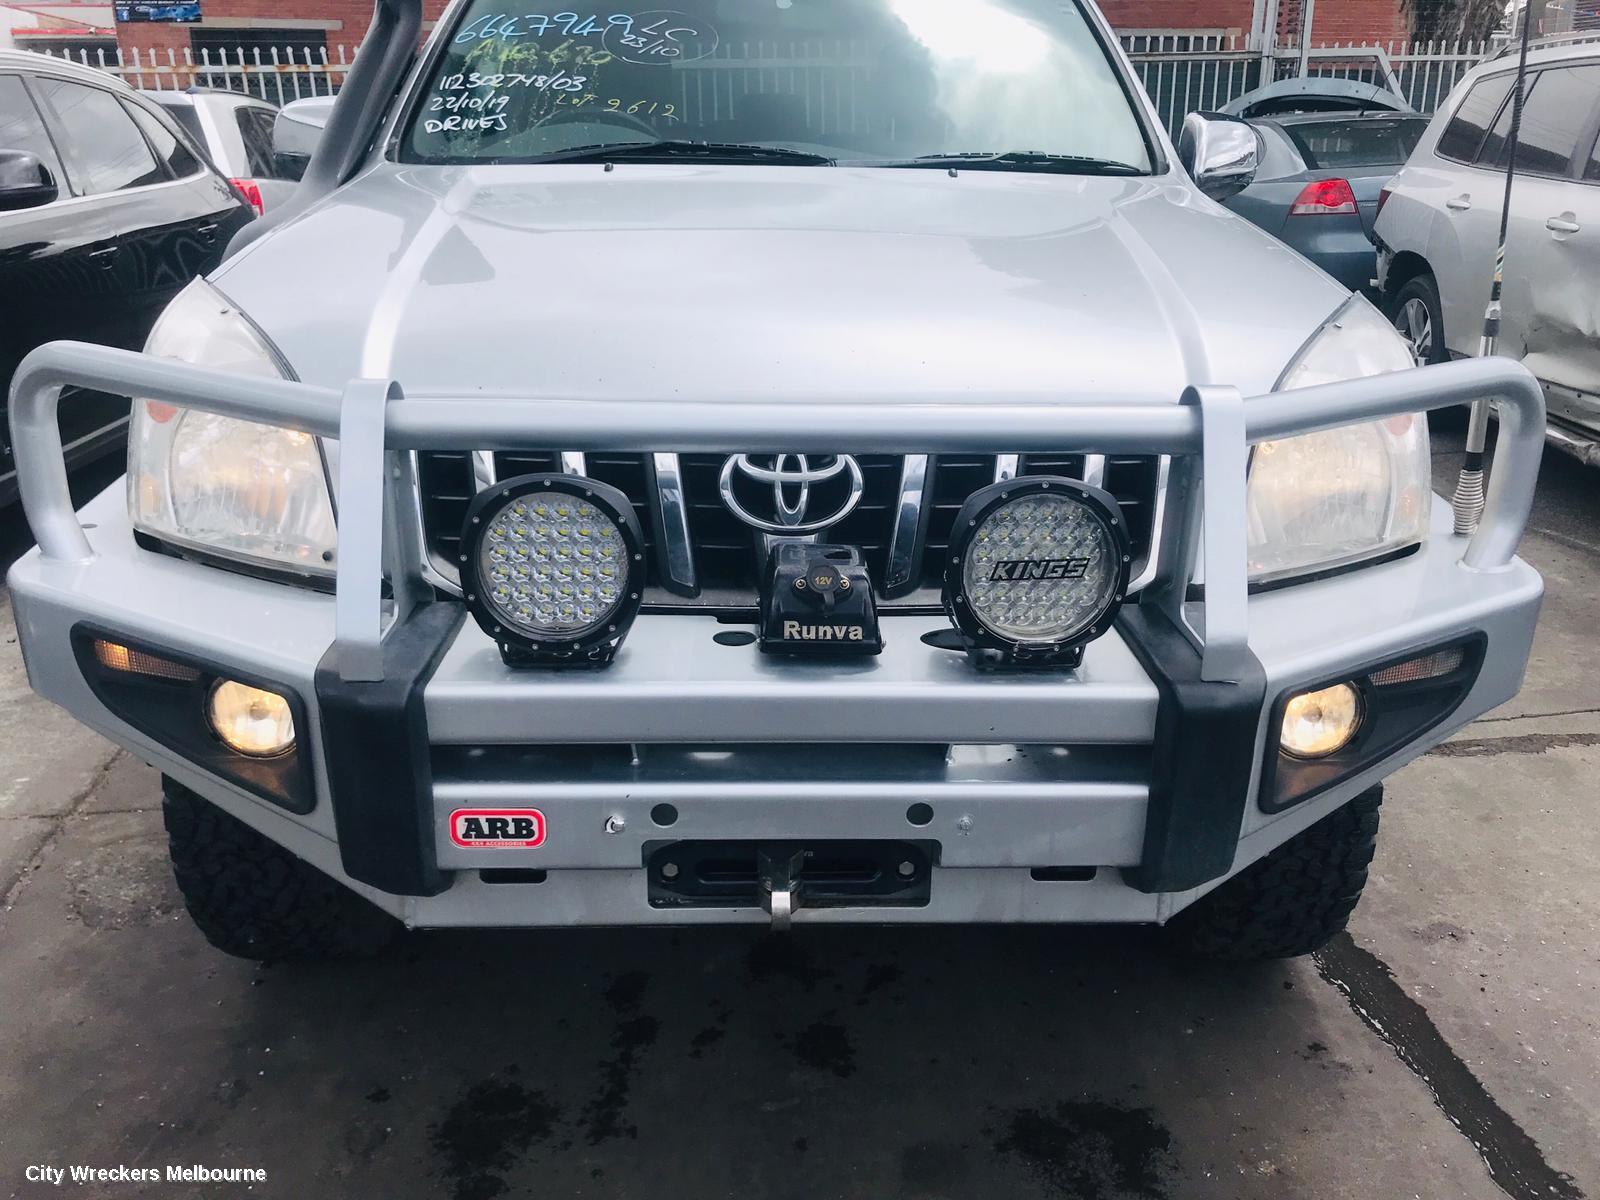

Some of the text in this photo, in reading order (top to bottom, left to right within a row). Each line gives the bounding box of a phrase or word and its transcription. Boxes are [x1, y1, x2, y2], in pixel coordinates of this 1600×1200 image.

[430, 91, 510, 113] 22/10/19
[603, 98, 680, 121] 2612
[424, 113, 508, 134] DRIVES
[814, 575, 833, 585] 12V
[989, 557, 1091, 582] KINGS
[783, 620, 863, 640] Runva
[461, 817, 536, 839] ARB
